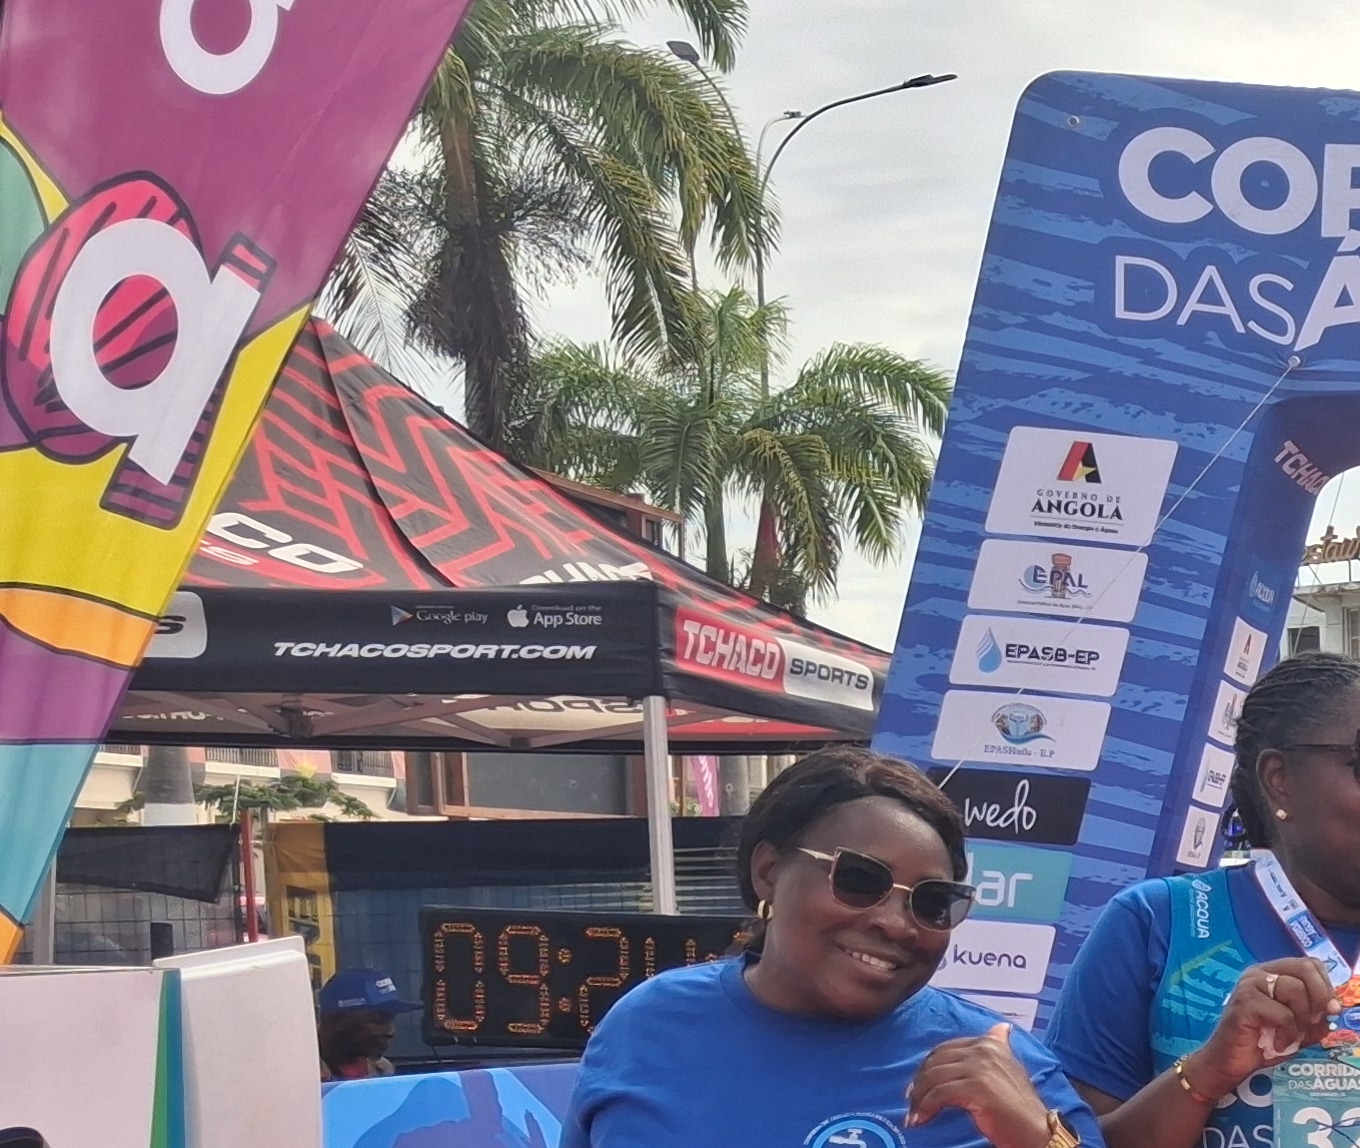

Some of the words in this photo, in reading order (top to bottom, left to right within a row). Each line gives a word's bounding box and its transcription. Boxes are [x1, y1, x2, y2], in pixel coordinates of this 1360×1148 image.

[1031, 498, 1124, 521] ANGOLA
[415, 609, 461, 626] Google
[464, 611, 489, 625] play
[533, 612, 564, 628] App
[565, 612, 603, 626] Store
[273, 641, 597, 661] TCHACOSPORT.COM
[683, 619, 781, 681] TCHACO
[1005, 642, 1100, 665] EPASB-EP
[789, 657, 870, 691] SPORTS
[964, 778, 1037, 835] wedo
[1196, 890, 1210, 939] ACQUA
[953, 943, 1027, 970] kuena
